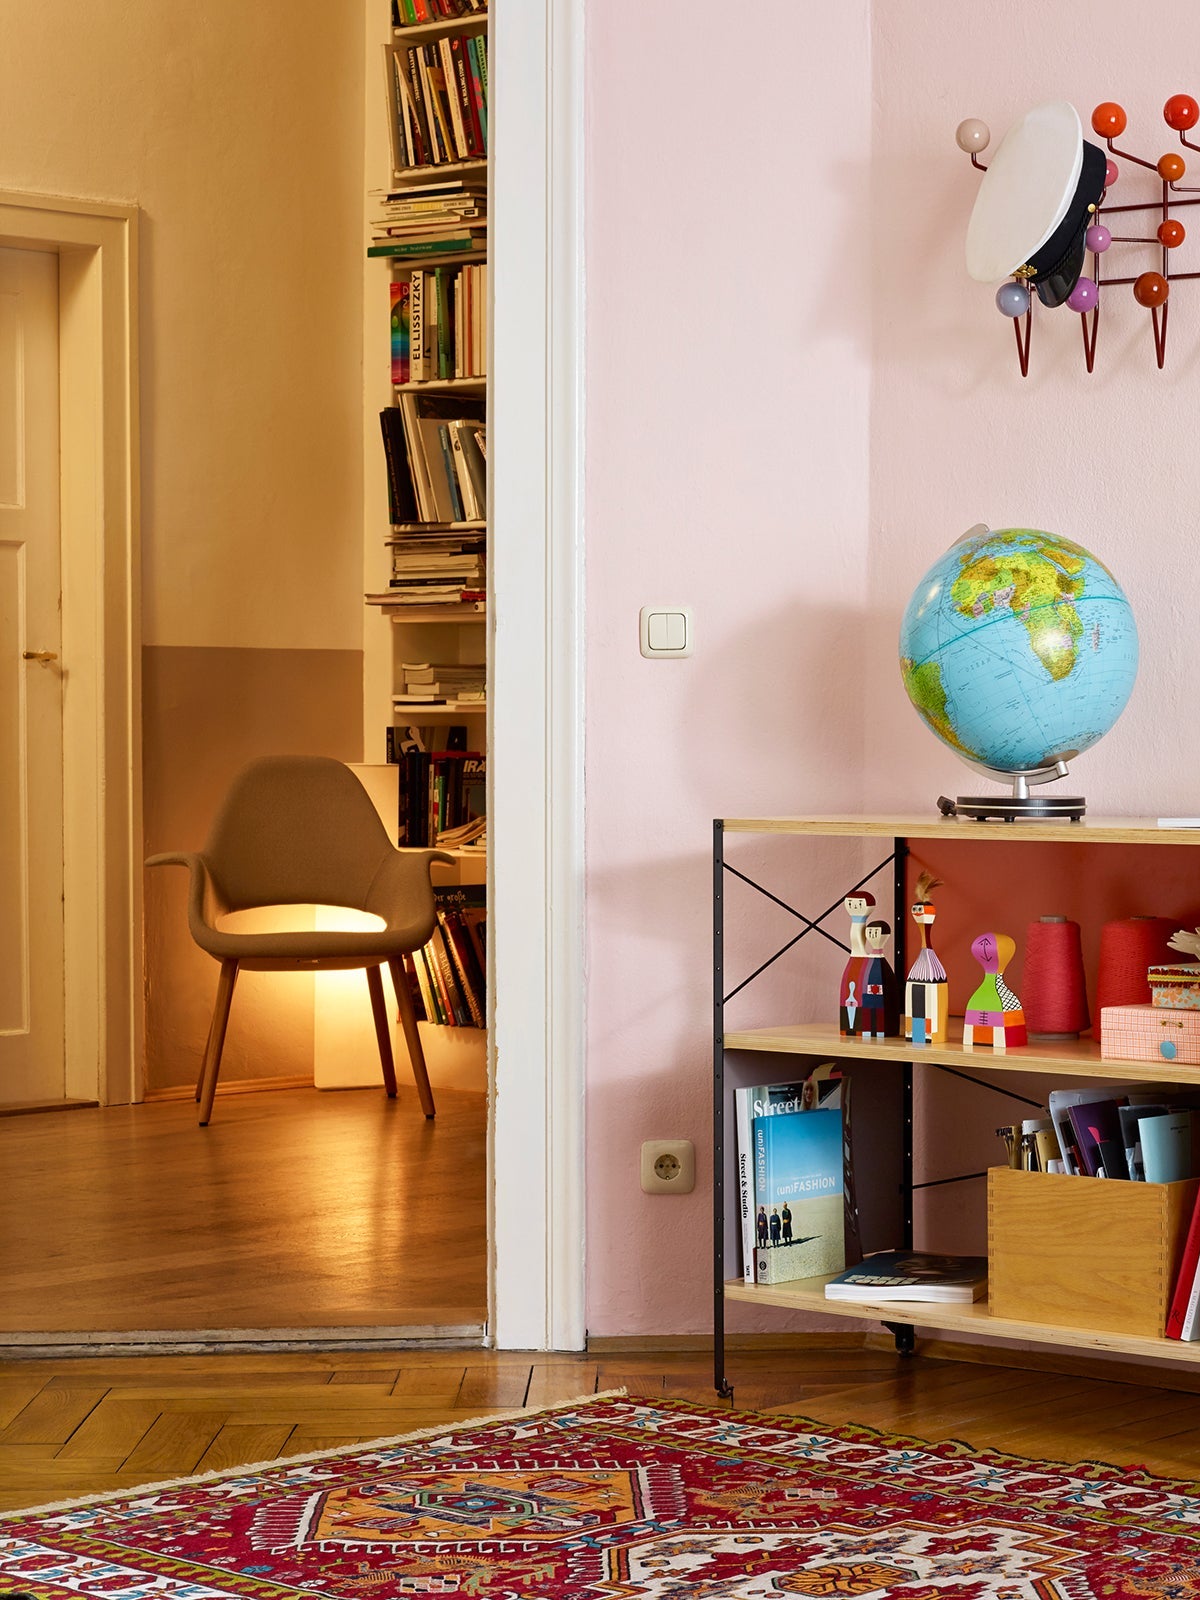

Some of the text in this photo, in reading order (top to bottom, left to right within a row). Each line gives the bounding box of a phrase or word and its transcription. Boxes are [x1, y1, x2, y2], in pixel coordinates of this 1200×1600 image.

[412, 275, 421, 360] EL LISSITZKY
[753, 1097, 802, 1118] Street
[739, 1153, 749, 1219] Street & Studio
[757, 1129, 767, 1193] (un)FASHION
[776, 1176, 836, 1197] (un)FASHION
